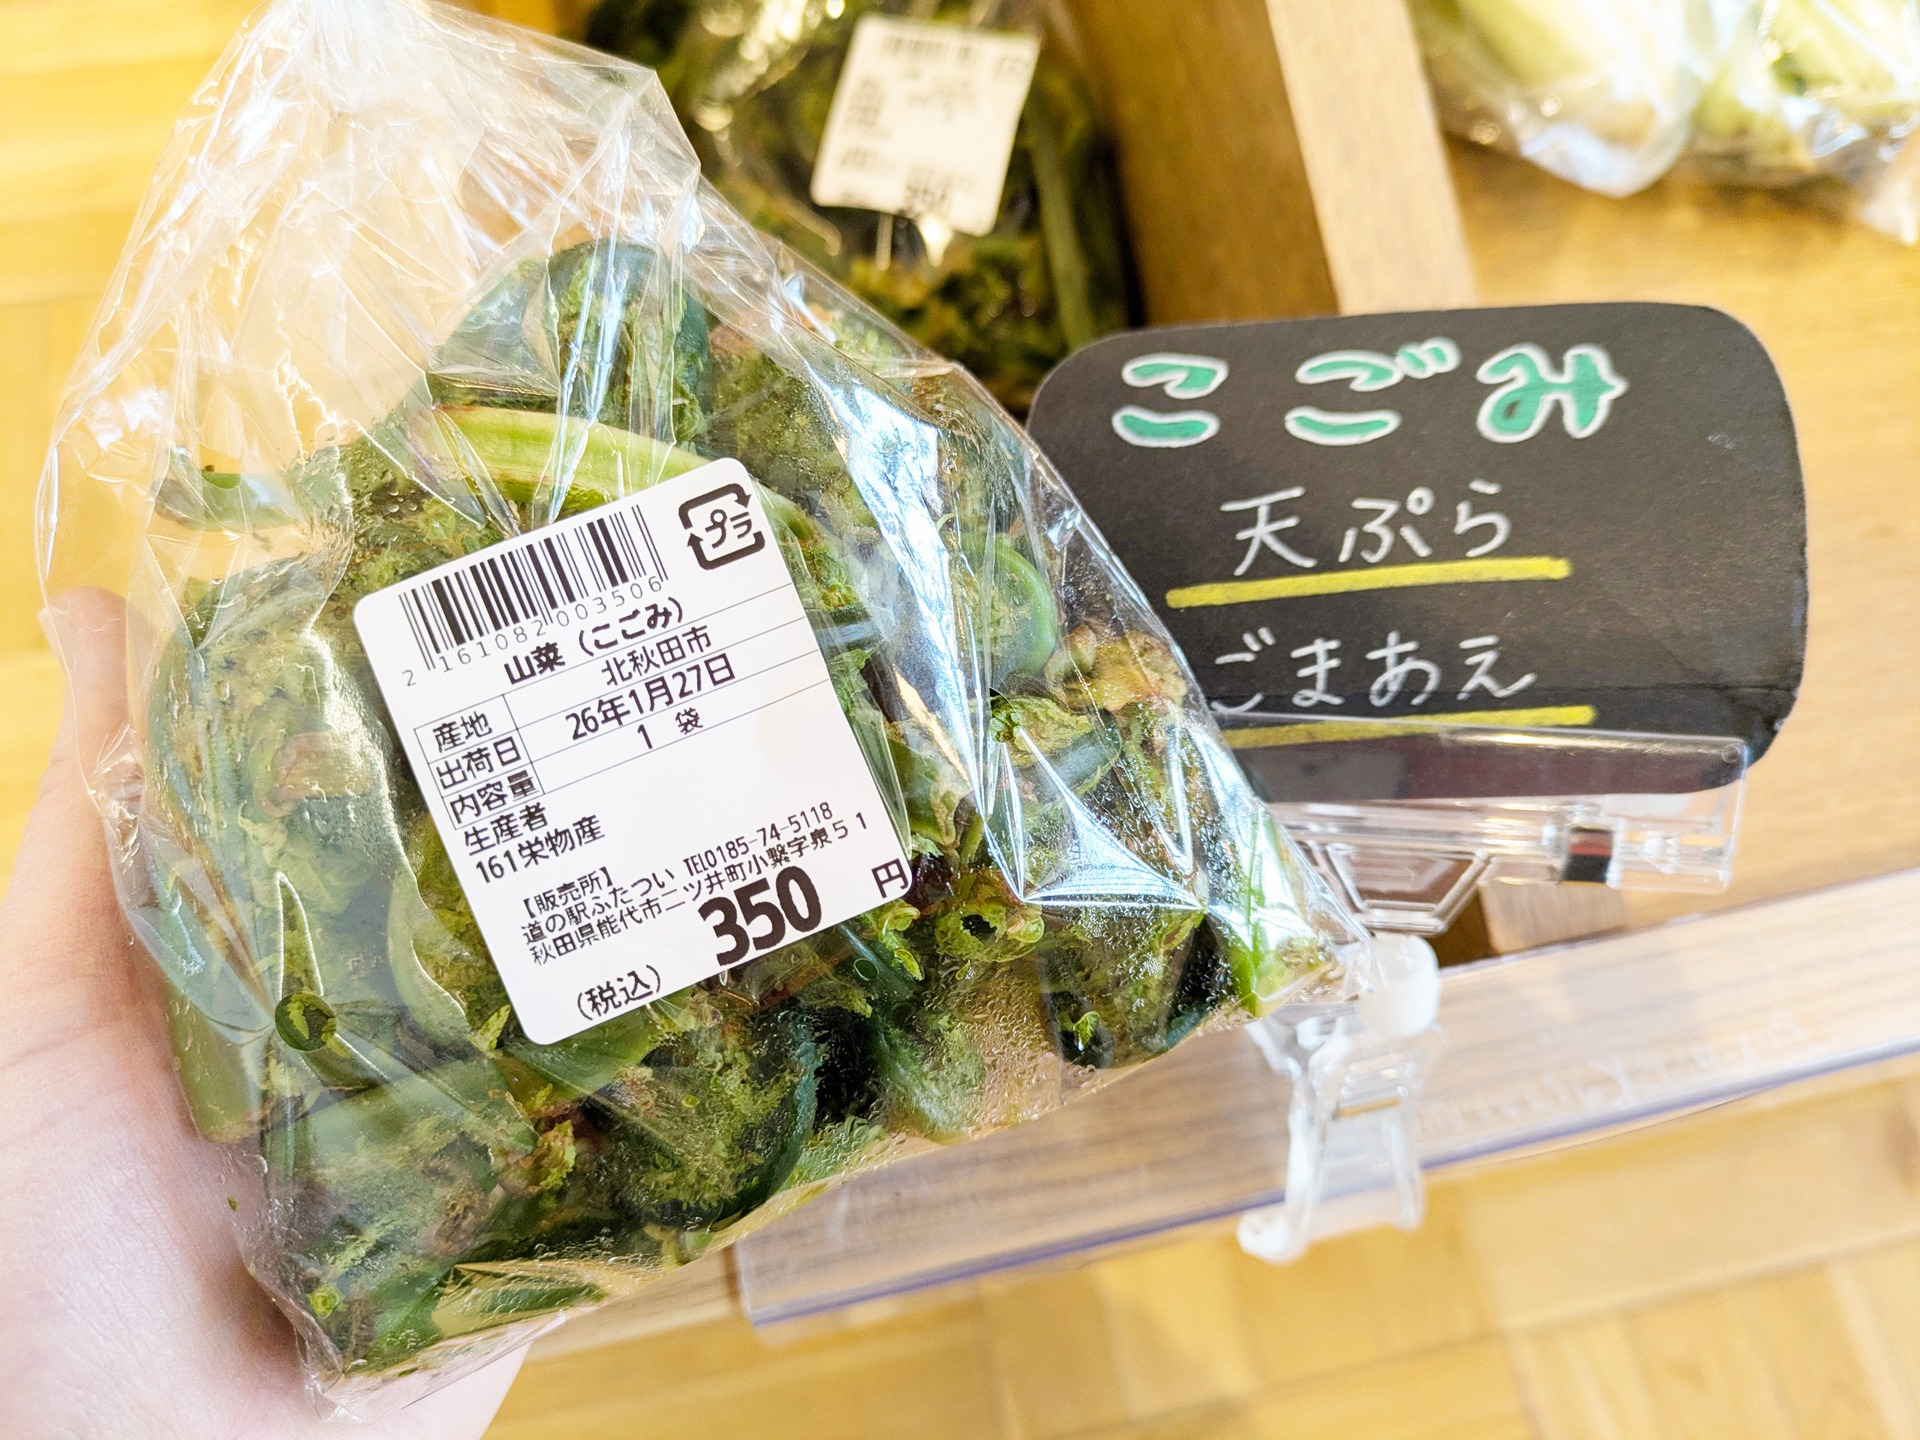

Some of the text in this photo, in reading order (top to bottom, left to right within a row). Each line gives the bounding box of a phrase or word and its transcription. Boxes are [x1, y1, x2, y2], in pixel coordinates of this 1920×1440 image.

[1111, 336, 1630, 448] こごみ
[1219, 480, 1512, 576] 天ぷら
[504, 597, 685, 686] 山菜（こごみ）
[601, 625, 713, 688] 北秋田市
[1210, 626, 1538, 714] ごまあえ
[432, 711, 492, 753] 産地
[565, 653, 736, 742] 26年1月27日
[636, 707, 704, 750] 1 袋
[435, 738, 522, 790] 出荷日
[449, 769, 539, 820] 内容量
[463, 802, 549, 857] 生産者
[475, 813, 606, 885] 161栄物産
[521, 868, 675, 946] 道の駅ふたつい
[697, 858, 909, 967] 350 円
[577, 964, 661, 1021] (税込)
